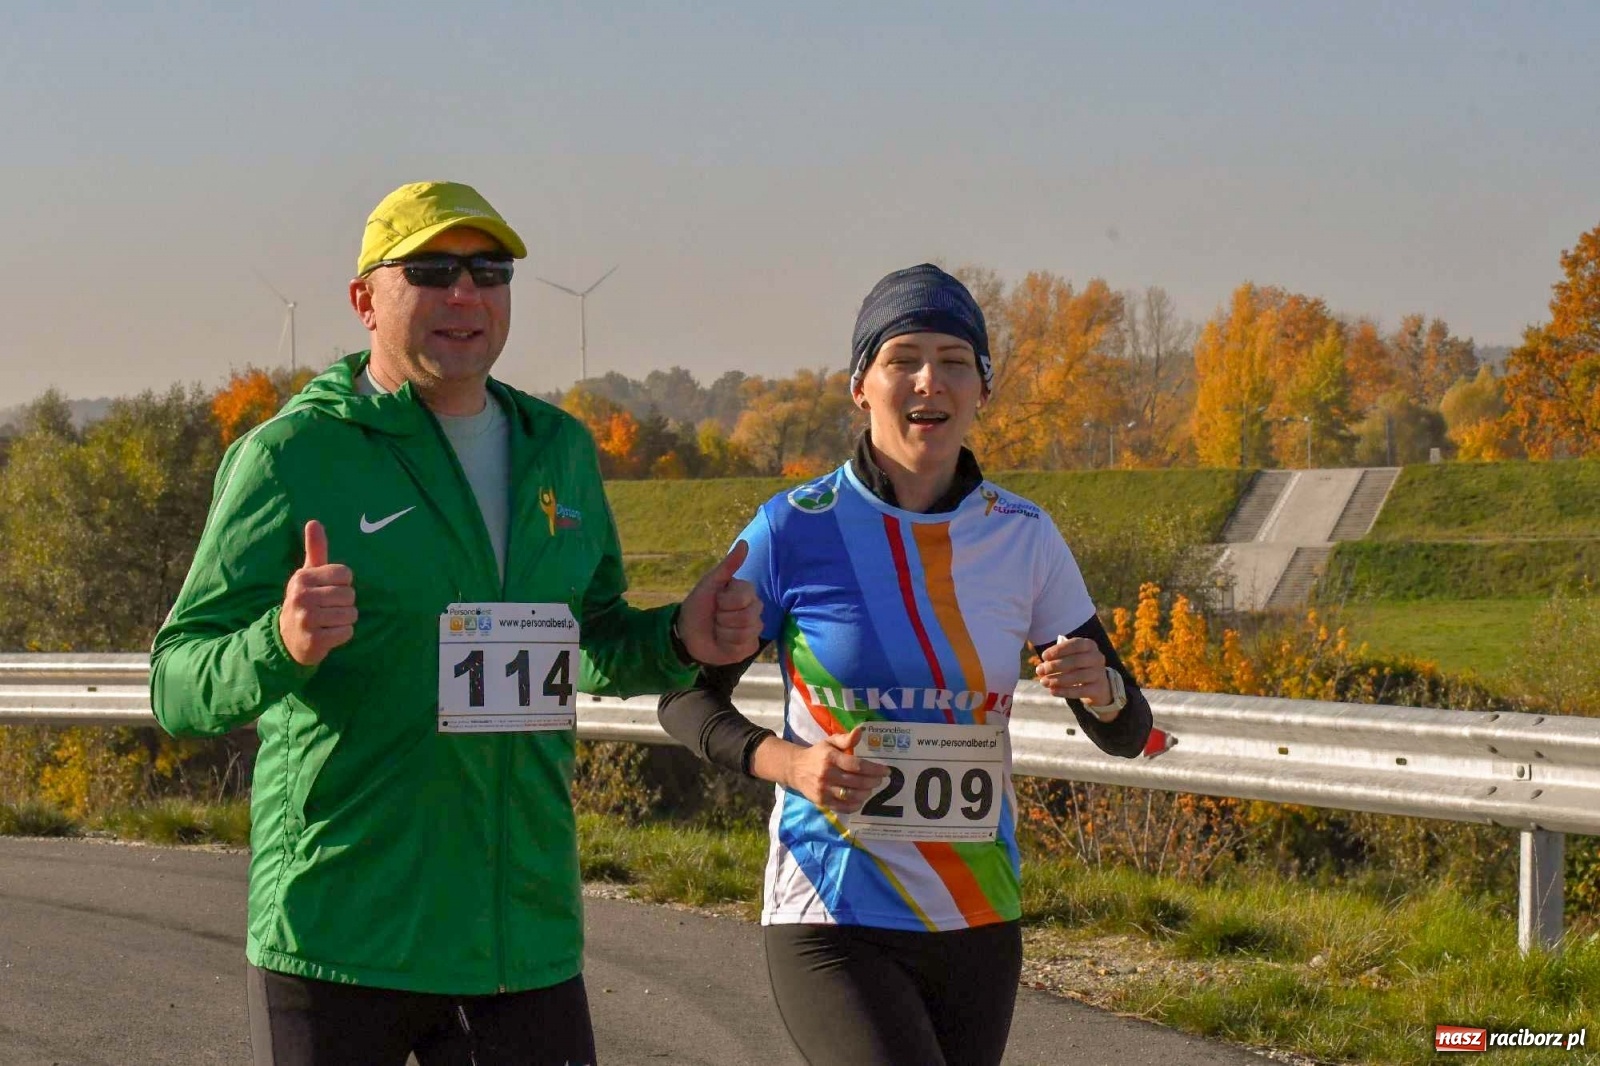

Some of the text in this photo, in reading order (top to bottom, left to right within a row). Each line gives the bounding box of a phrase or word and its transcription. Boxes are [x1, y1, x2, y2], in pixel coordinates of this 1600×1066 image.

[499, 618, 575, 630] www.personalbest.pl
[454, 650, 573, 707] 114
[917, 738, 997, 748] www.personalbest.pl
[861, 766, 993, 820] 209
